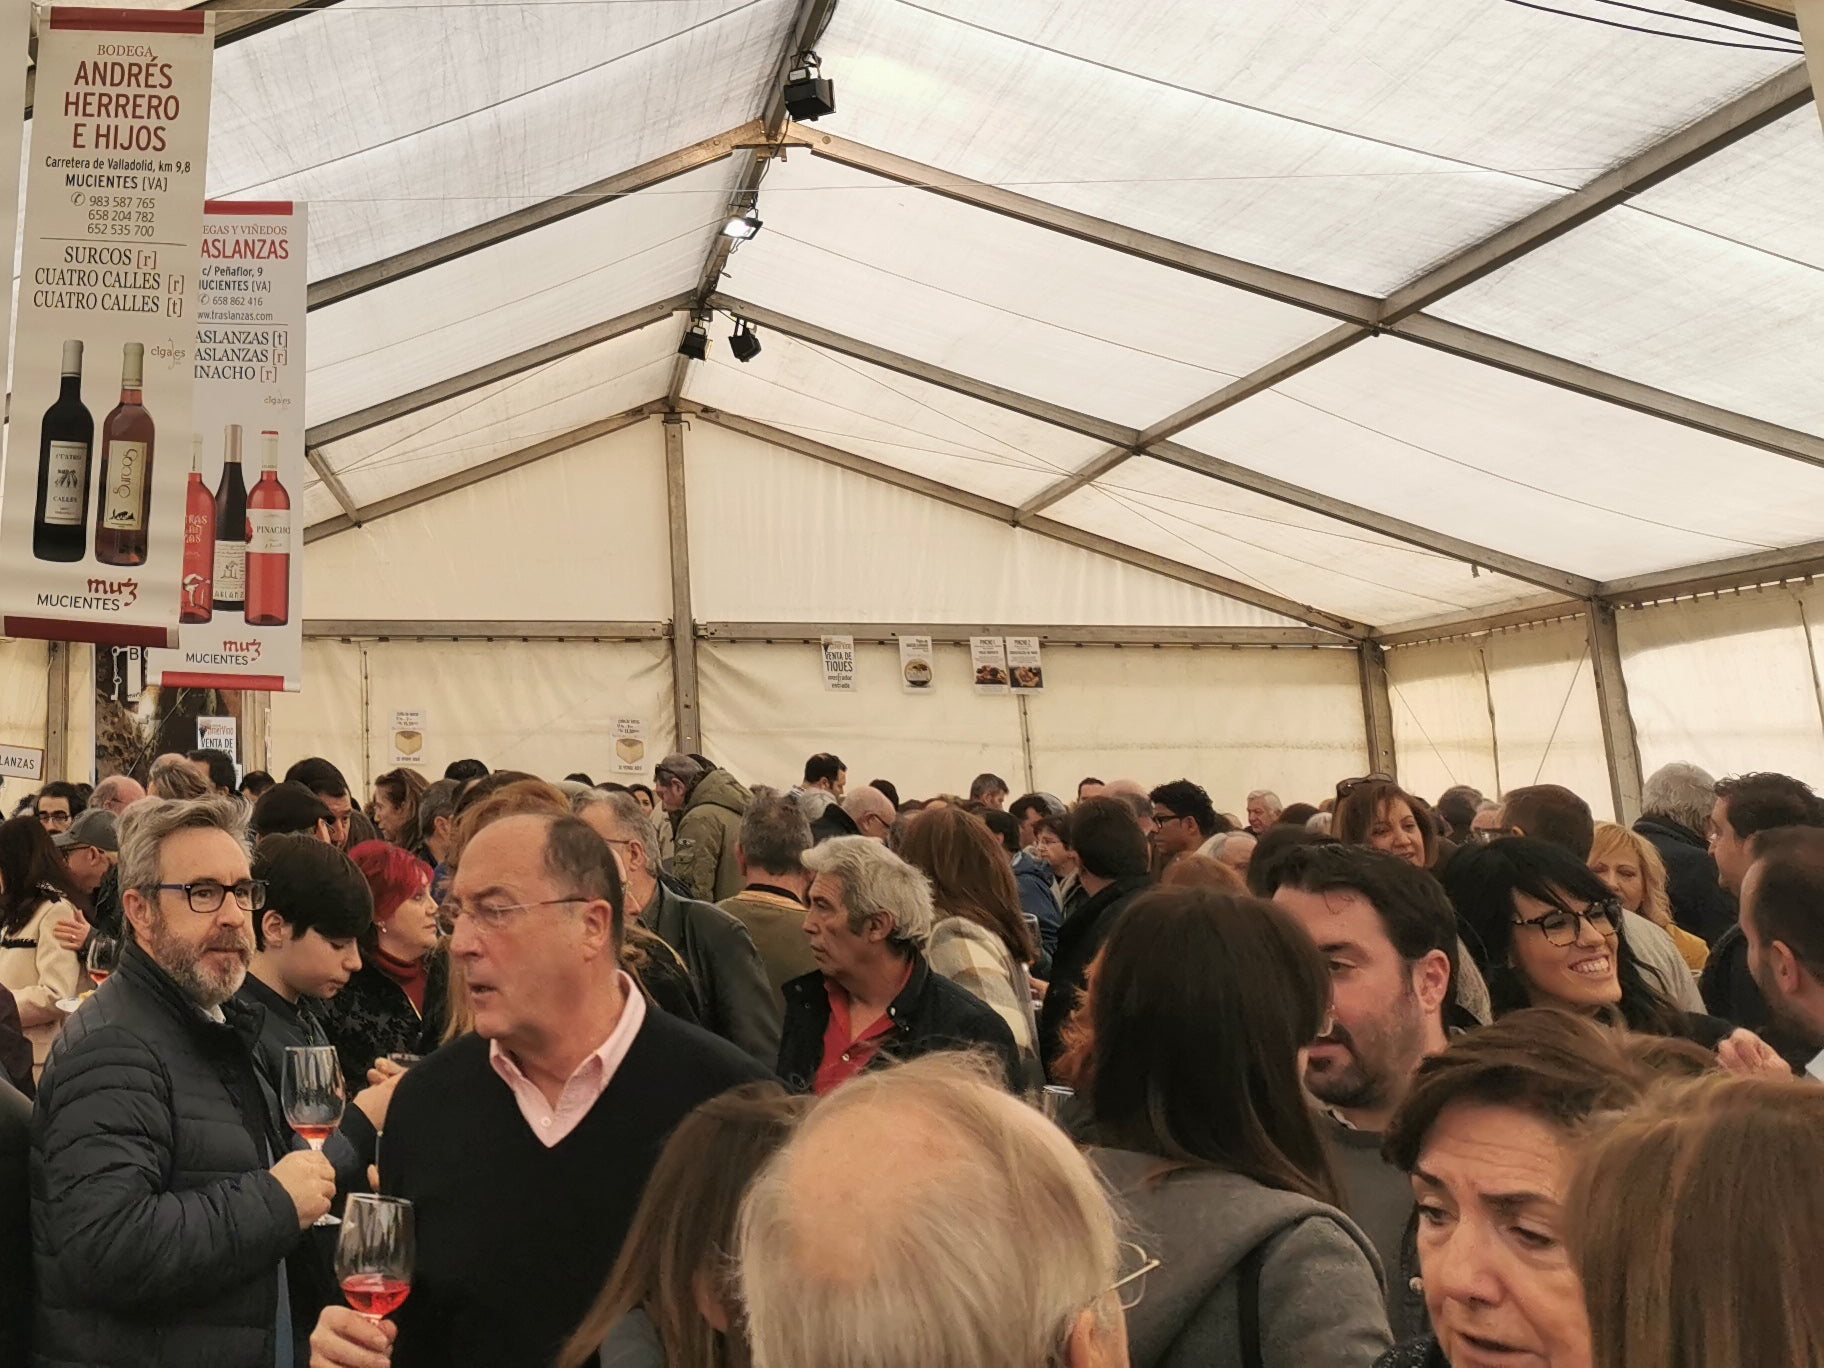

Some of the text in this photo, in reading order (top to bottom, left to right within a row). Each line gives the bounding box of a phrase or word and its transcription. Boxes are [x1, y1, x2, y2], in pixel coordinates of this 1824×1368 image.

[97, 44, 154, 58] BODEGA
[74, 56, 173, 89] ANDRÉS
[64, 91, 180, 121] HERRERO
[72, 122, 167, 152] E HIJOS
[45, 155, 191, 176] Carretera de Valladolid, km 9,8
[65, 173, 168, 192] MUCIENTES [VA]
[89, 195, 155, 209] 983 587 765
[88, 209, 155, 223] 658 204 782
[87, 223, 154, 237] 652 535 700
[203, 223, 288, 236] EGAS Y VIÑEDOS
[200, 238, 289, 260] ASLANZAS
[64, 245, 157, 270] SURCOS [r]
[257, 267, 263, 277] 9
[35, 267, 185, 295] CUATRO CALLES [r]
[33, 289, 97, 311] CUATRO
[101, 293, 160, 313] CALLES
[212, 296, 228, 306] 658
[247, 296, 263, 306] 416
[197, 310, 273, 321] ww.traslanzas.com
[196, 330, 269, 345] ASLANZAS
[195, 347, 269, 363] ASLANZAS
[194, 364, 256, 380] INACHO
[36, 593, 120, 612] MUCIENTES
[185, 652, 249, 666] MUCIENTES
[201, 738, 233, 749] VENTA DE
